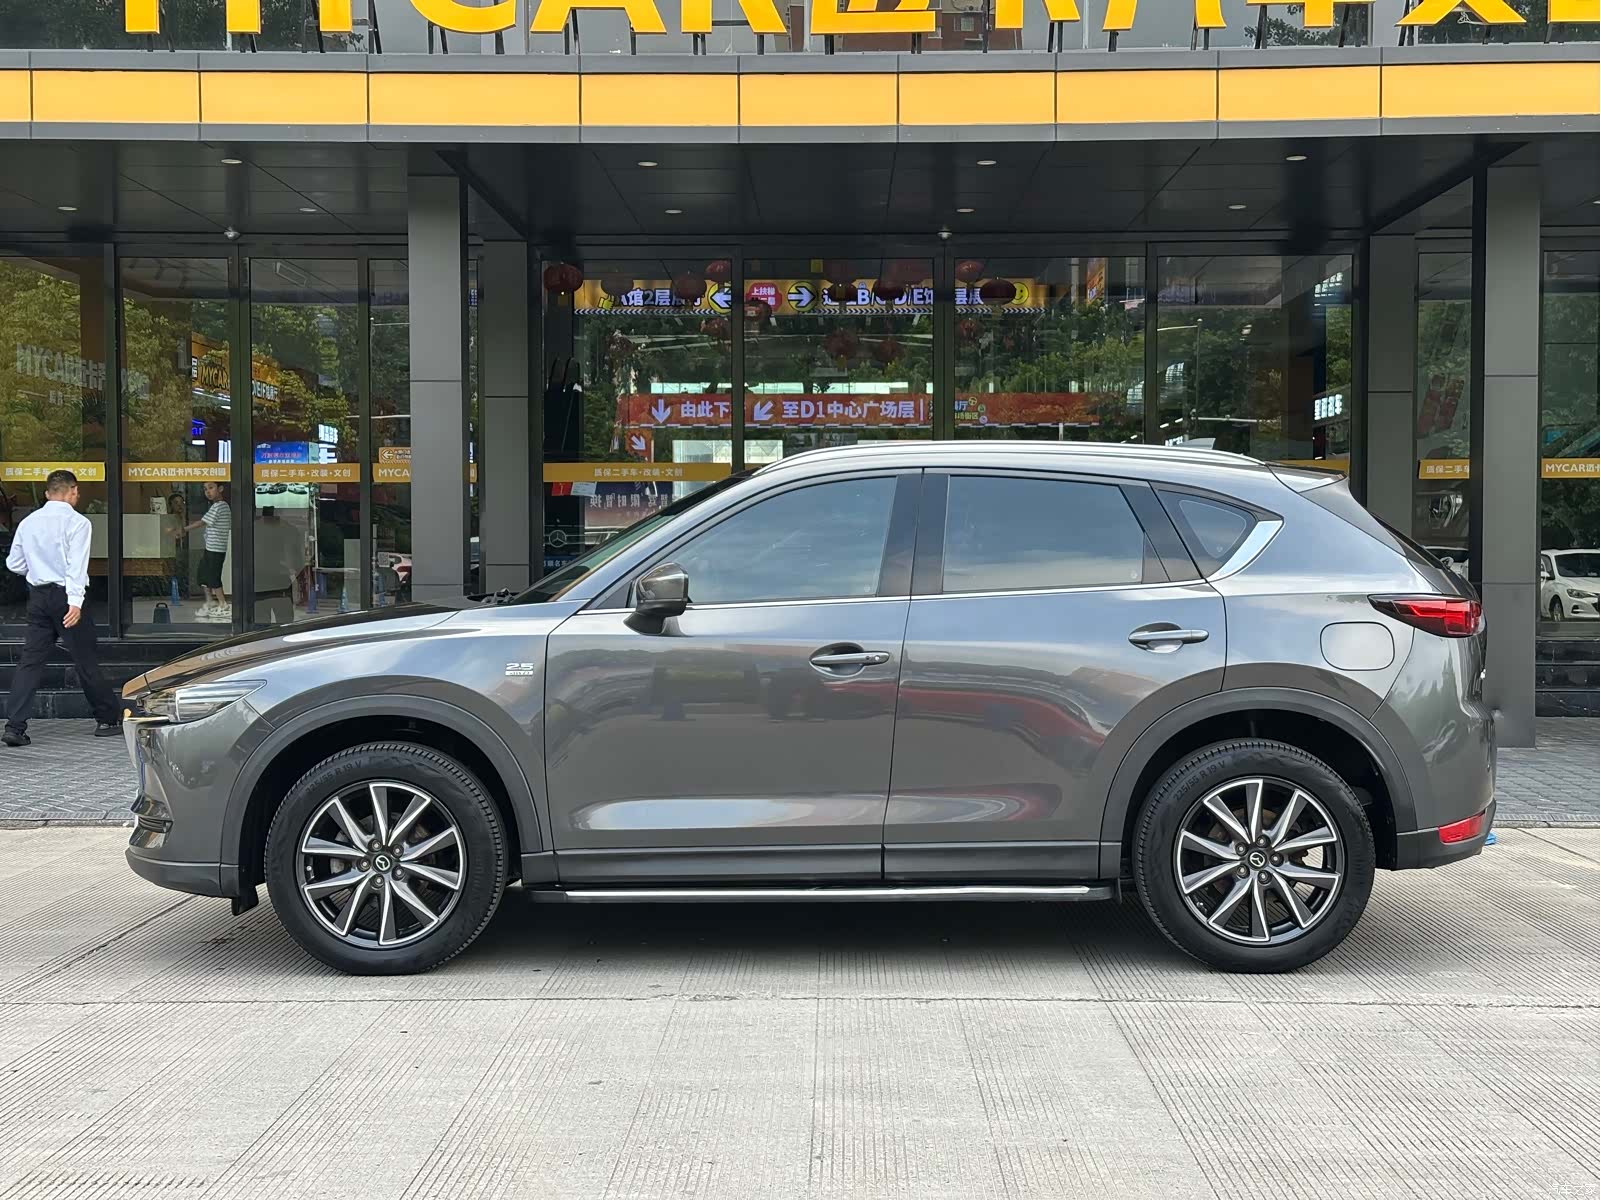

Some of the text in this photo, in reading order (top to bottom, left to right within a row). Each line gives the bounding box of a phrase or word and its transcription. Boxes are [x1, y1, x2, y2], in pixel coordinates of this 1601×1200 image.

[782, 400, 914, 418] 至D1中心广场层
